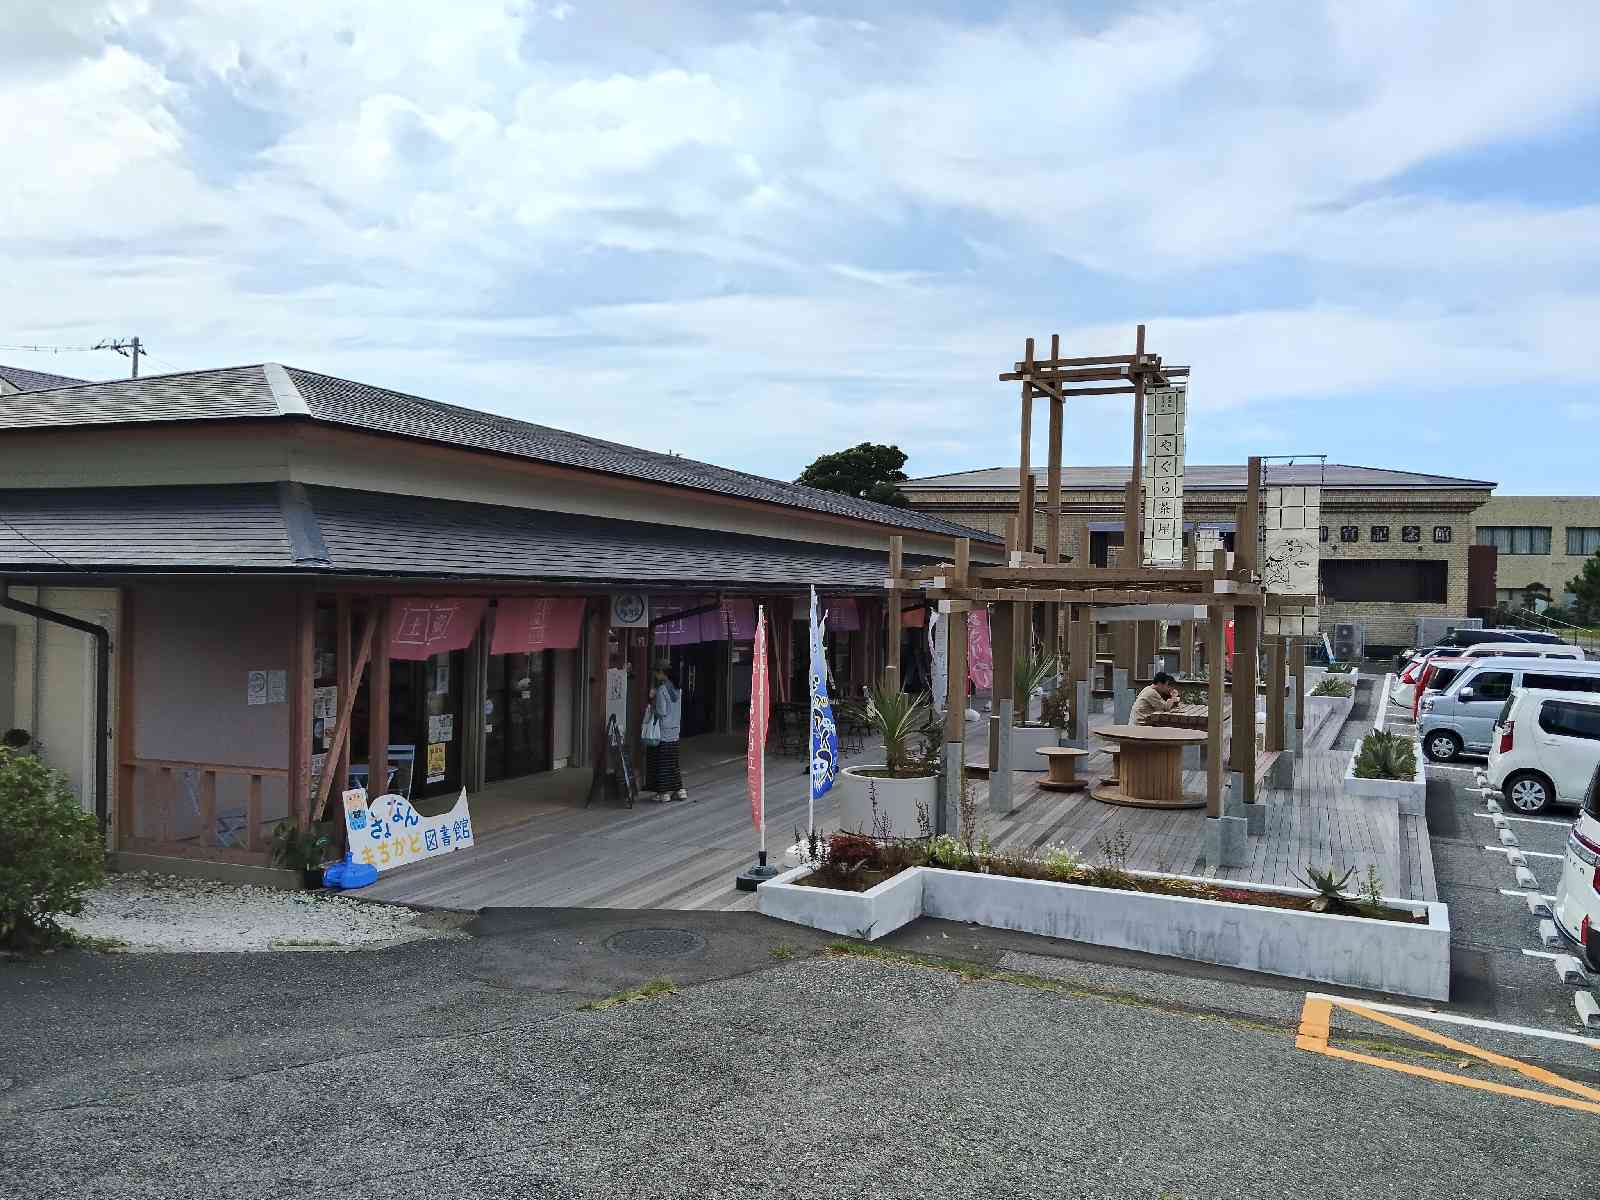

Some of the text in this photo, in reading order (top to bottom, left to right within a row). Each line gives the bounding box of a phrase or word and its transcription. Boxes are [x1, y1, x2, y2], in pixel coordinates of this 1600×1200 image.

[1158, 438, 1173, 536] やぐら茶屋
